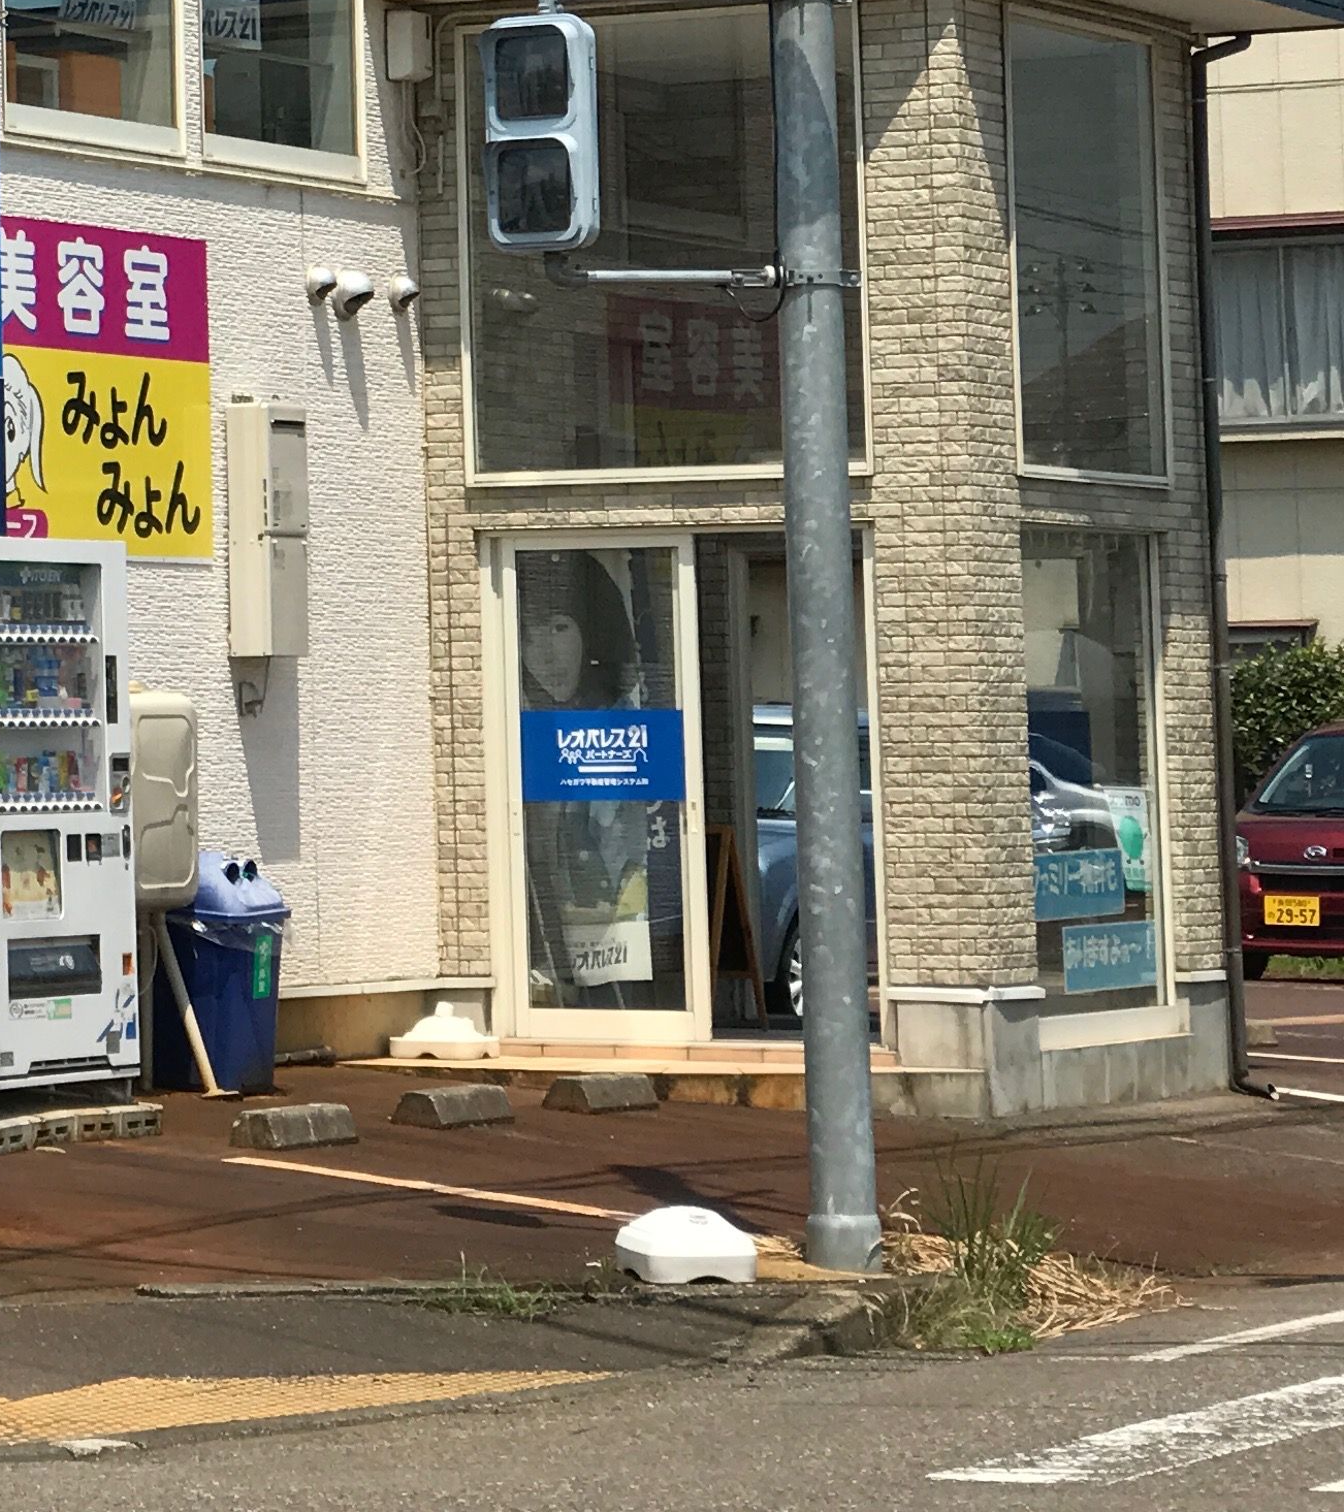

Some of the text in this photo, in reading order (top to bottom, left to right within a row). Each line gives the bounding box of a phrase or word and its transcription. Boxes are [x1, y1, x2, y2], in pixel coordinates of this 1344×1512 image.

[62, 369, 168, 449] みょん
[96, 459, 202, 539] みょん
[5, 513, 38, 539] ーフ
[556, 724, 649, 749] レオパレス21
[1276, 907, 1317, 925] 29-57
